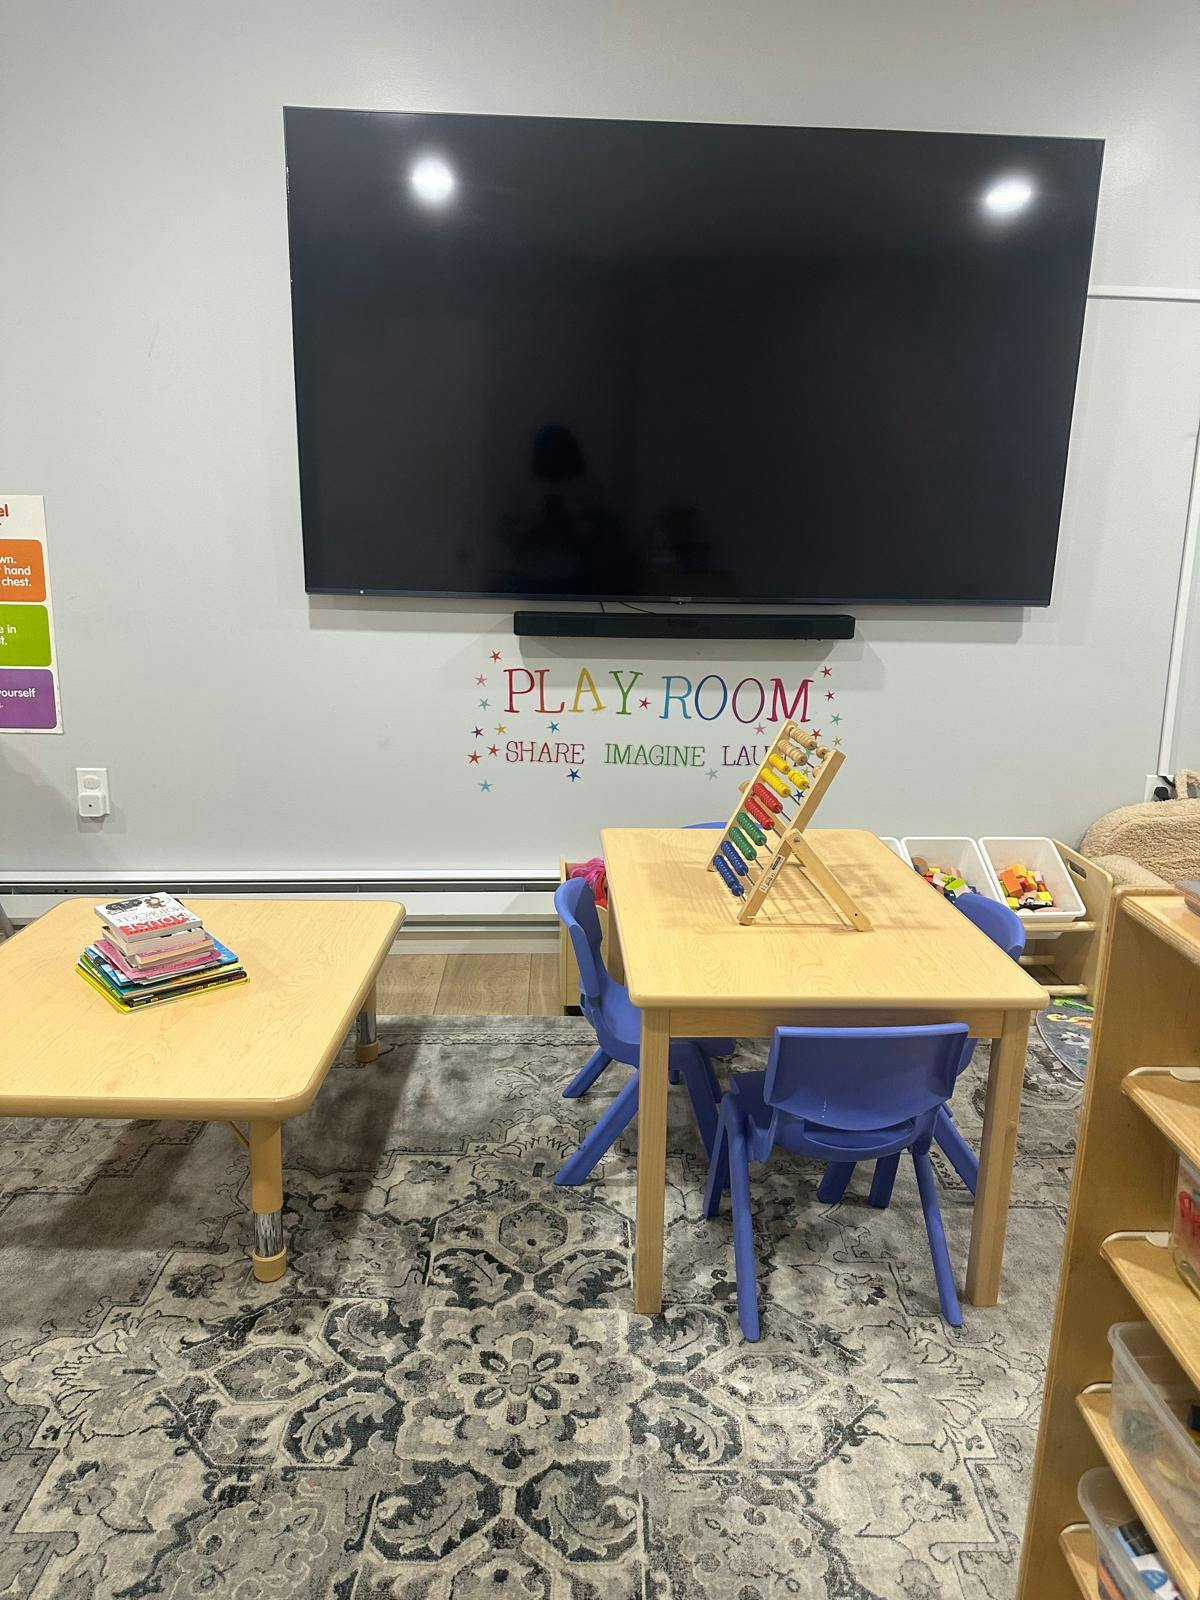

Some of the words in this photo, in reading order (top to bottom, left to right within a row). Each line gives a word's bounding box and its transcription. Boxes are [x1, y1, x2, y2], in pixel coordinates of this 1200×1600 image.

[4, 565, 31, 575] hand
[1, 576, 32, 587] chest.
[7, 624, 17, 634] in
[0, 688, 36, 698] ourself
[503, 667, 643, 715] PLAY
[659, 674, 814, 723] ROOM
[506, 740, 585, 764] SHARE
[604, 743, 705, 767] IMAGINE
[721, 745, 797, 767] LAU
[124, 912, 188, 932] MOUSE
